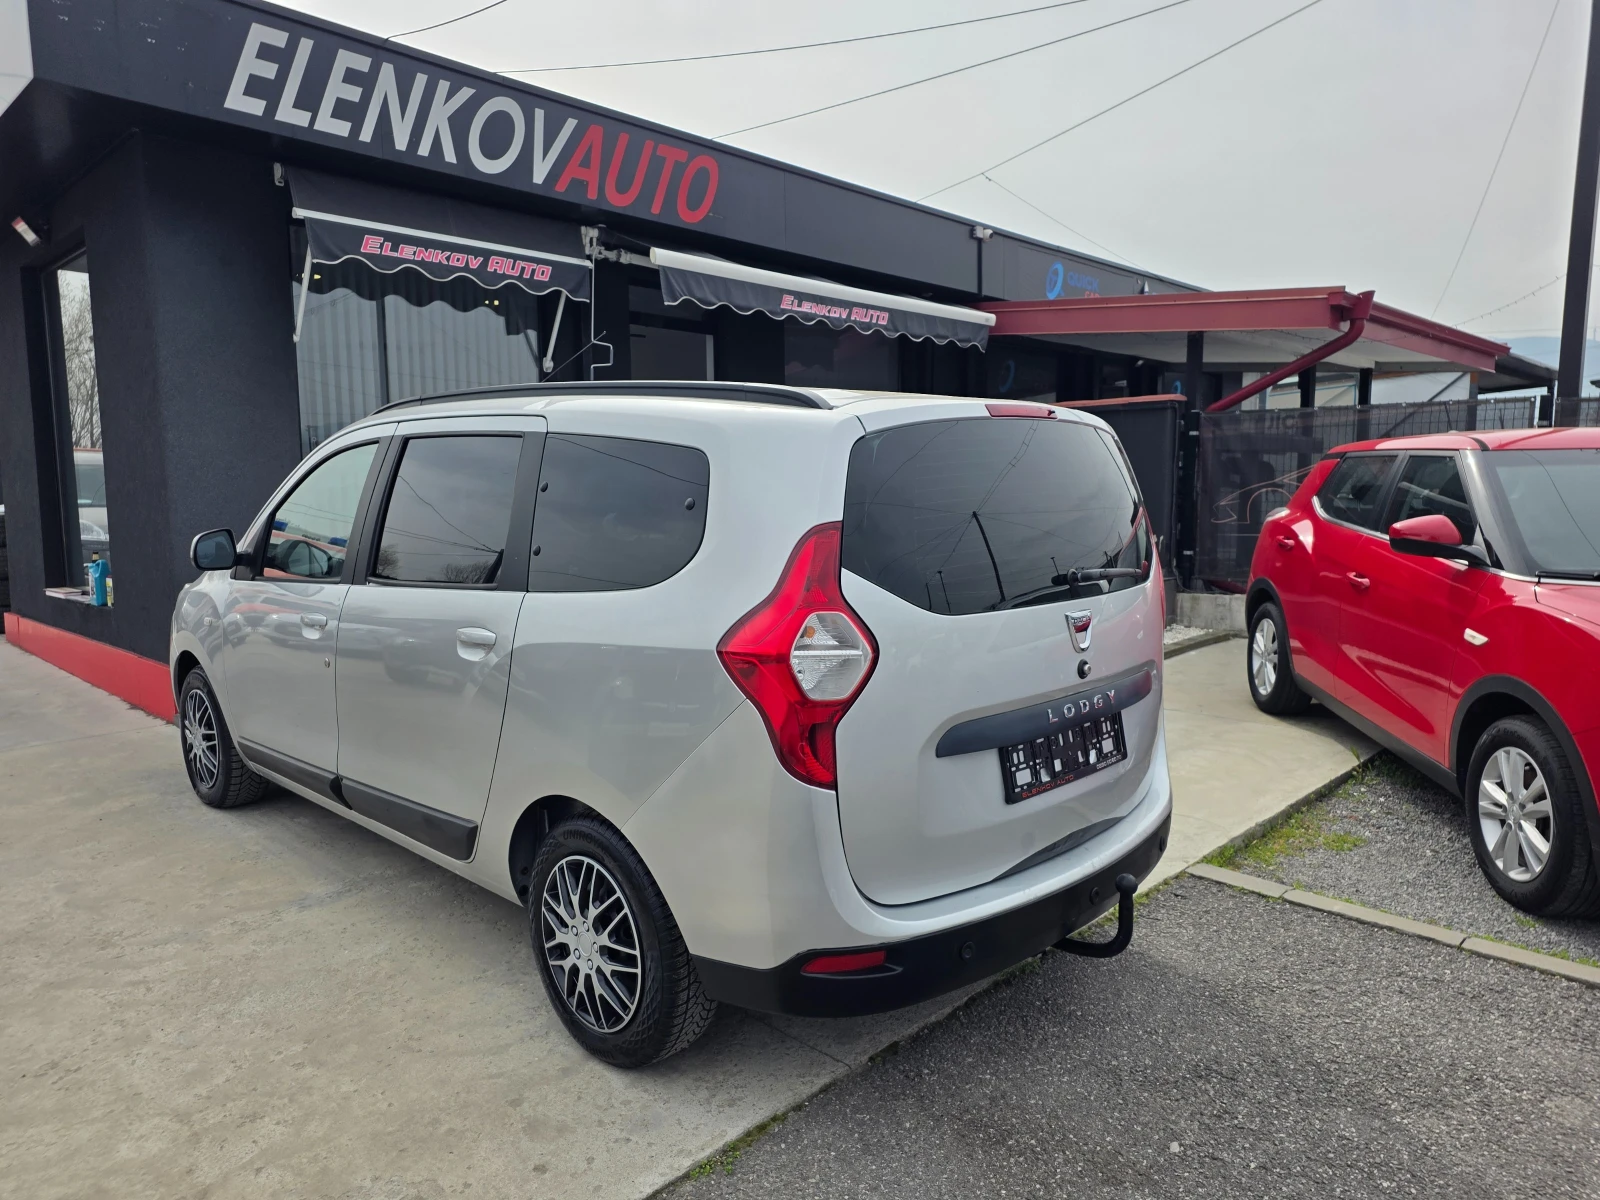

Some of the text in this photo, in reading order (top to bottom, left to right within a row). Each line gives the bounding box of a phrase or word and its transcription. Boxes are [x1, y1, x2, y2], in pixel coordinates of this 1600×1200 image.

[360, 234, 552, 282] ELENKOV AUTO
[1067, 271, 1099, 292] QUICK
[780, 294, 889, 325] ELENKOV AUTO
[1046, 689, 1116, 723] LODGY
[1056, 774, 1074, 785] AUTO
